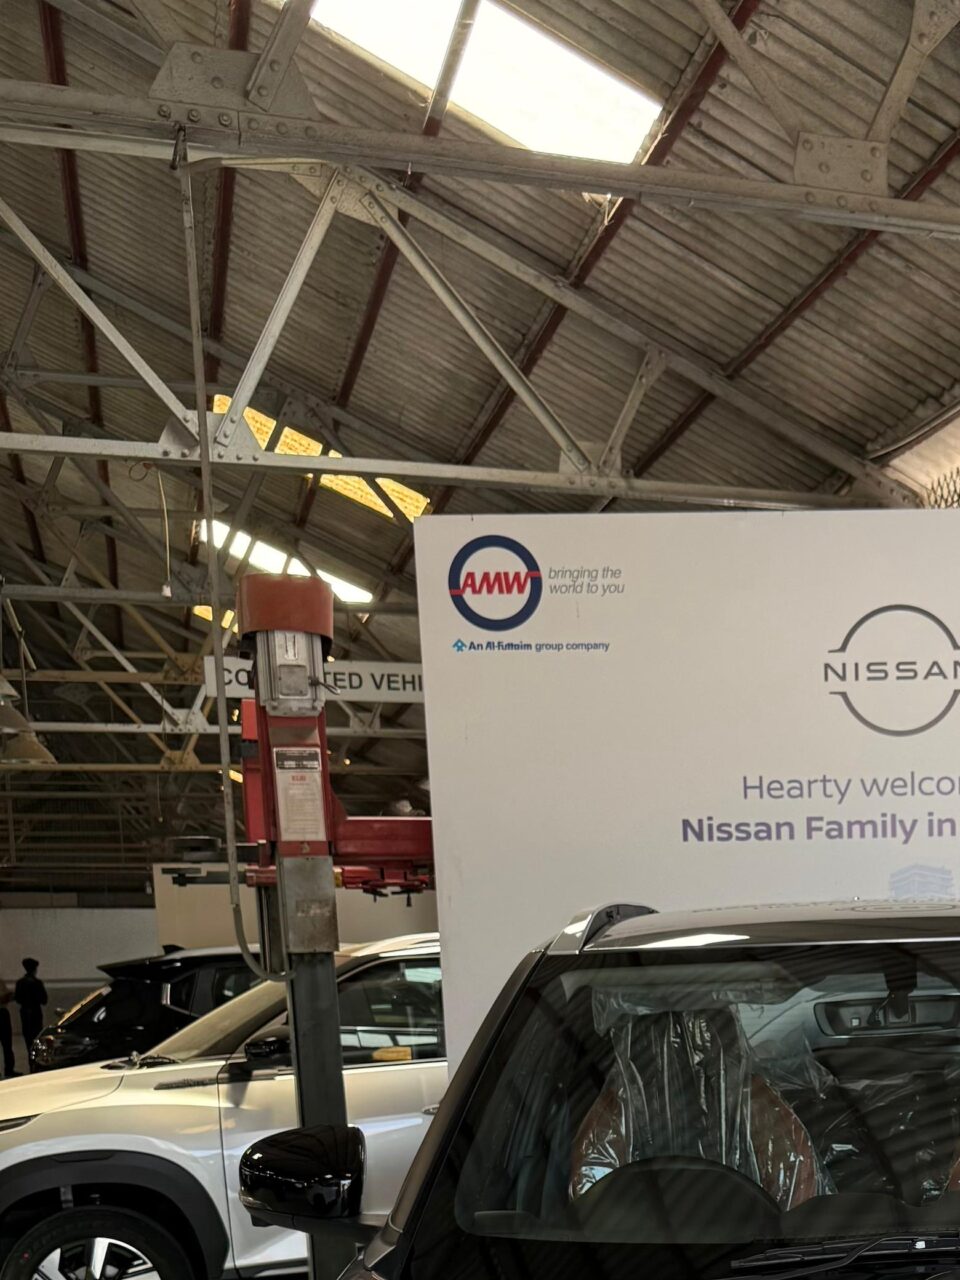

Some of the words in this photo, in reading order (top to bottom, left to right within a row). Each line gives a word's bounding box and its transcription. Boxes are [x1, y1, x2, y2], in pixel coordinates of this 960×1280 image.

[459, 571, 533, 595] AMW
[548, 566, 599, 582] bringing
[602, 566, 622, 580] the
[549, 581, 584, 594] world
[587, 582, 599, 594] to
[601, 583, 625, 597] you
[468, 641, 484, 651] An
[535, 642, 564, 652] group
[565, 642, 610, 652] company
[743, 774, 852, 805] Hearty
[682, 816, 796, 843] Nissan
[805, 812, 918, 845] Family
[927, 812, 957, 837] in
